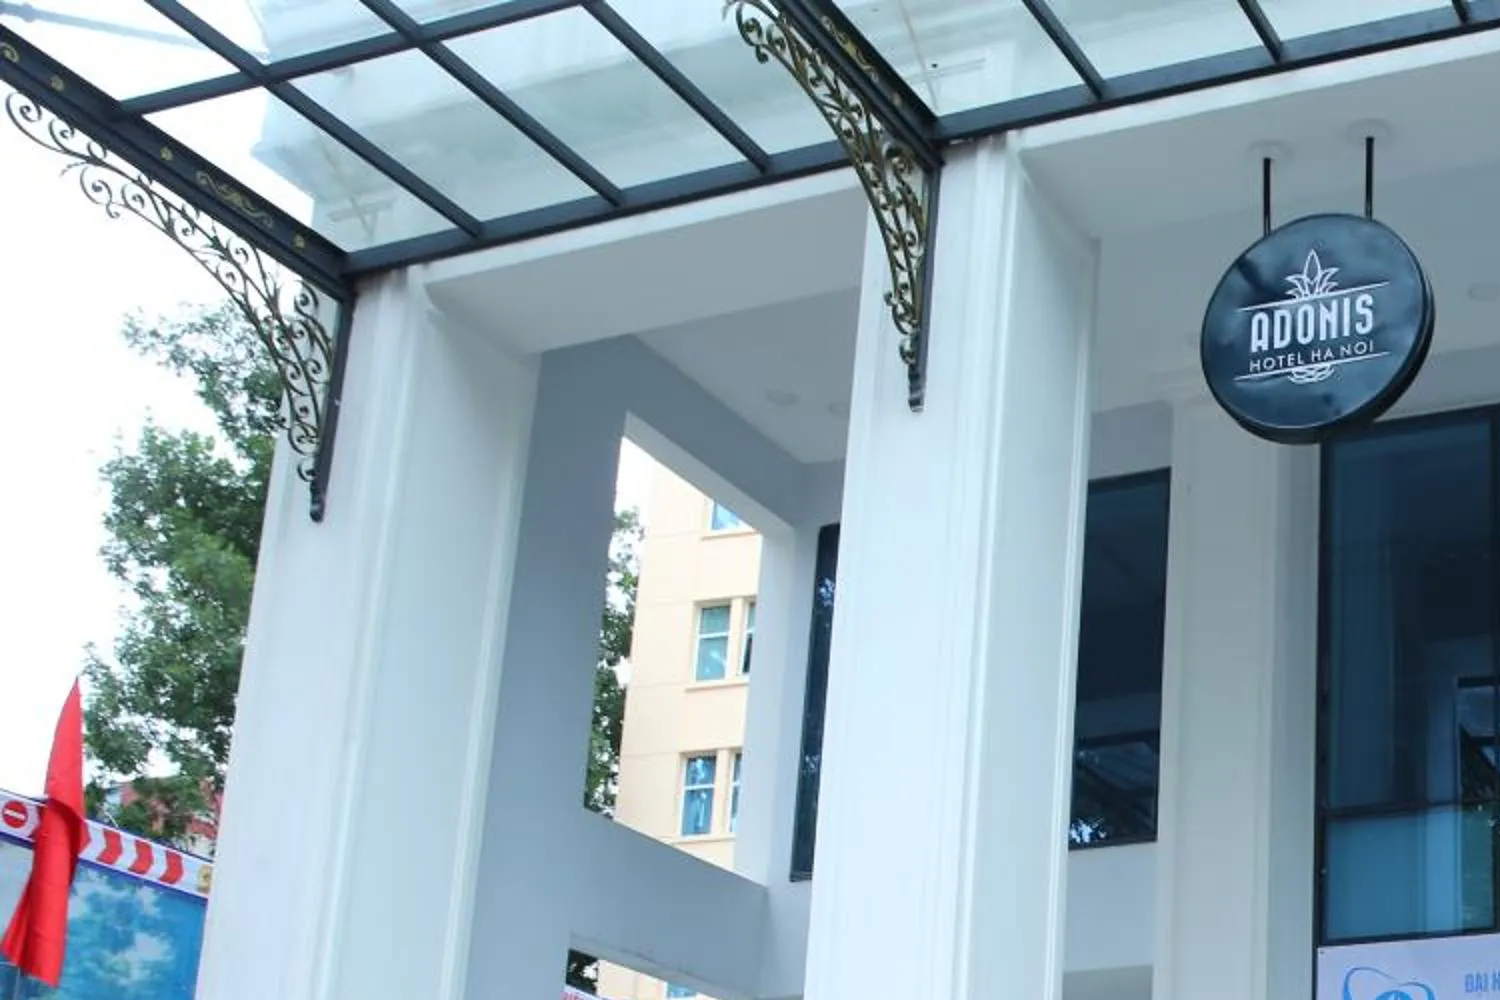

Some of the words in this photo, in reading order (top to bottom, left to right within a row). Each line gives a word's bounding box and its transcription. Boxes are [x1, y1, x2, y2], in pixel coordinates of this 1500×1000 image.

[1251, 294, 1374, 353] ADONIS
[1251, 352, 1304, 372] HOTEL
[1311, 346, 1334, 361] HA
[1340, 340, 1373, 356] NOI
